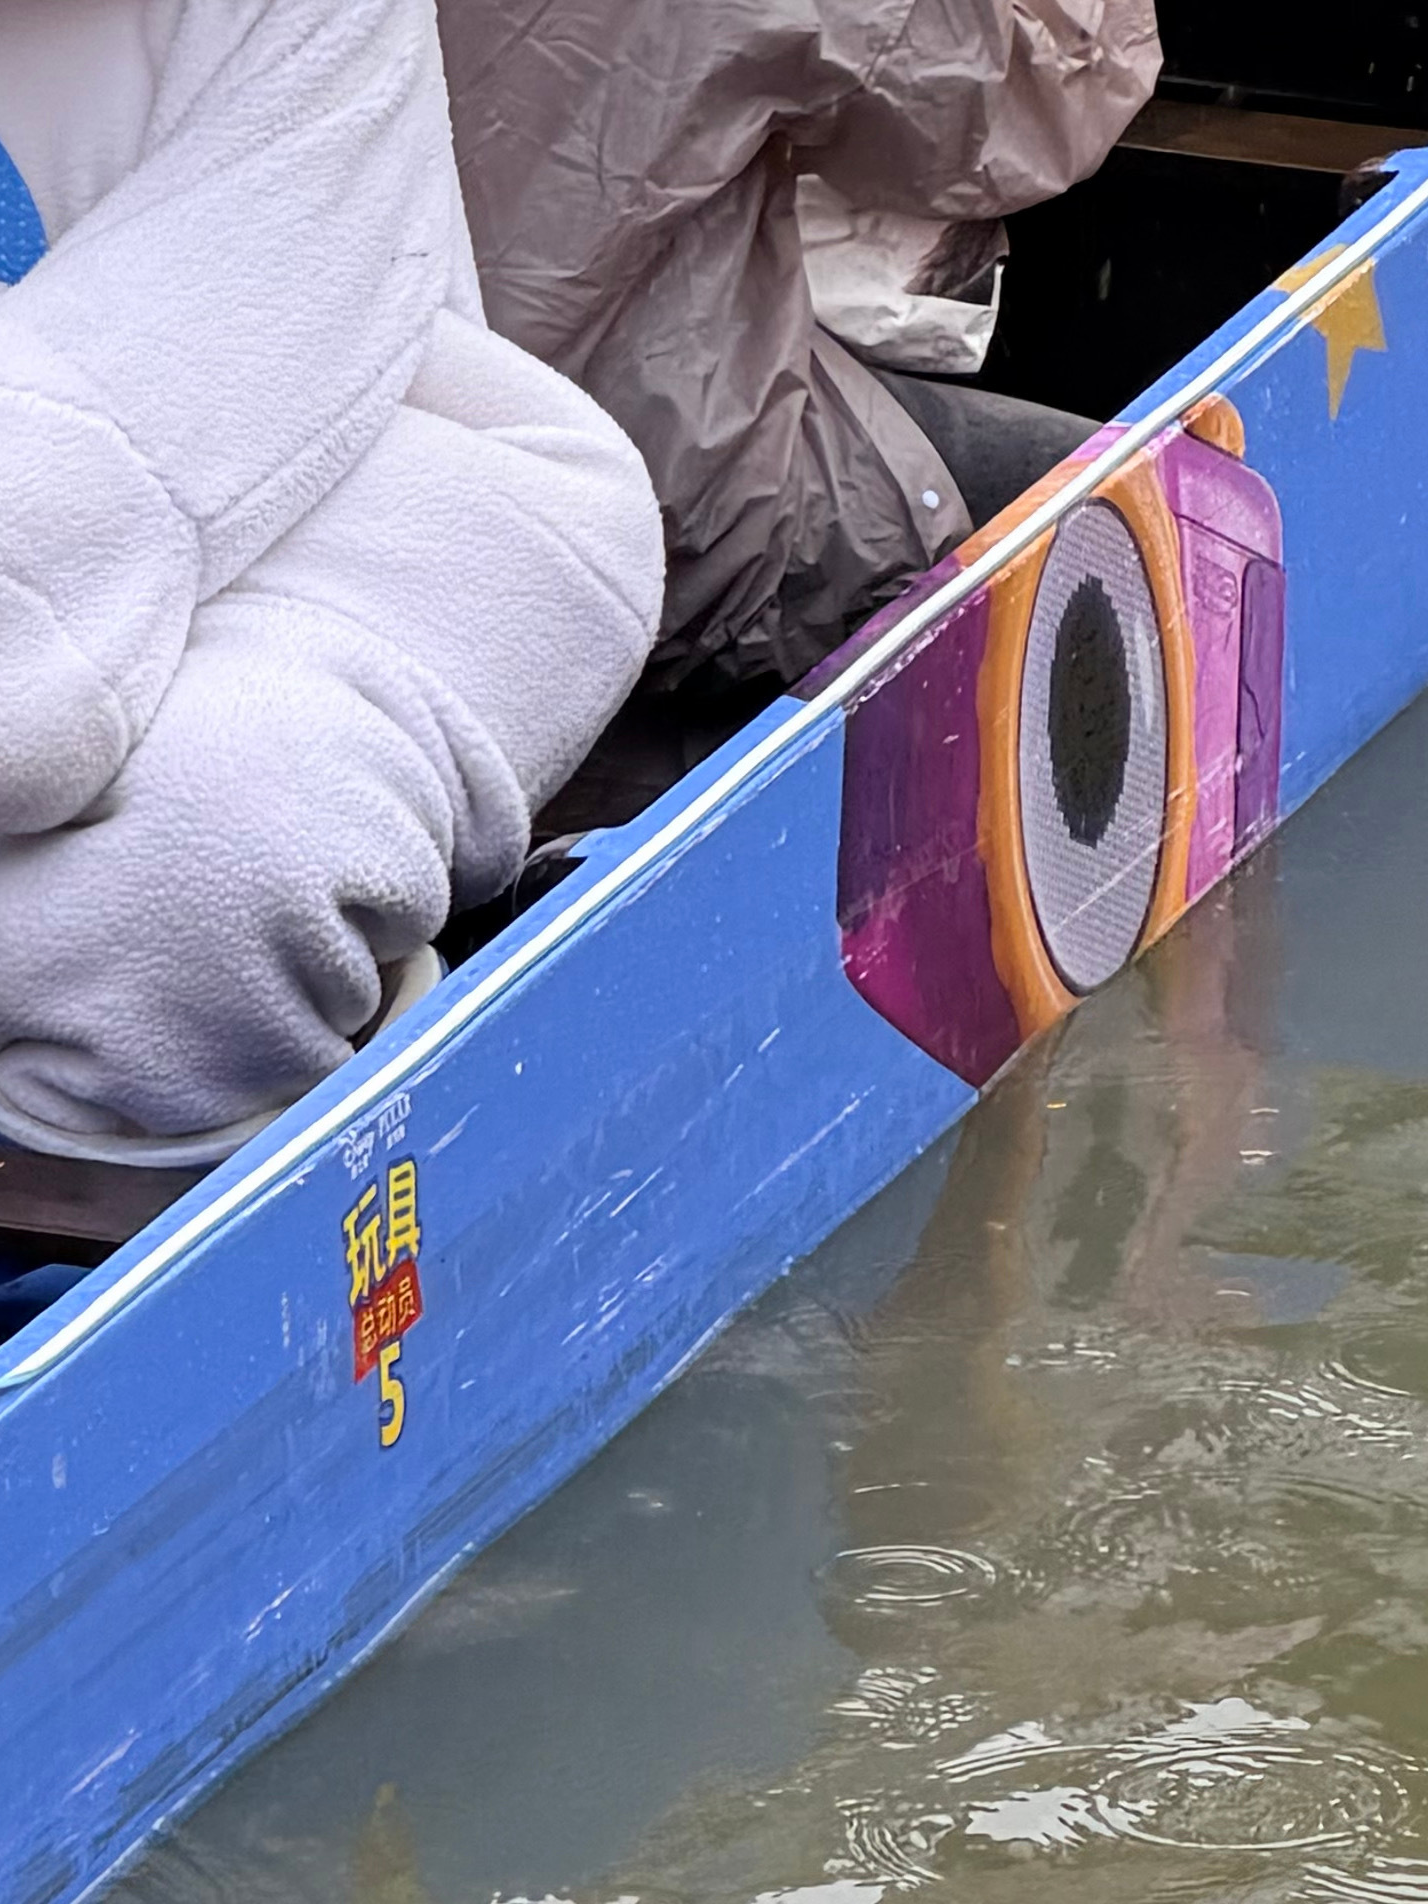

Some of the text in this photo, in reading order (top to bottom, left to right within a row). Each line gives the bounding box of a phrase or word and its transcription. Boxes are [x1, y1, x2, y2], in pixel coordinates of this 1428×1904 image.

[343, 1158, 421, 1307] 玩具
[360, 1275, 416, 1354] 总动员
[379, 1340, 406, 1449] 5
